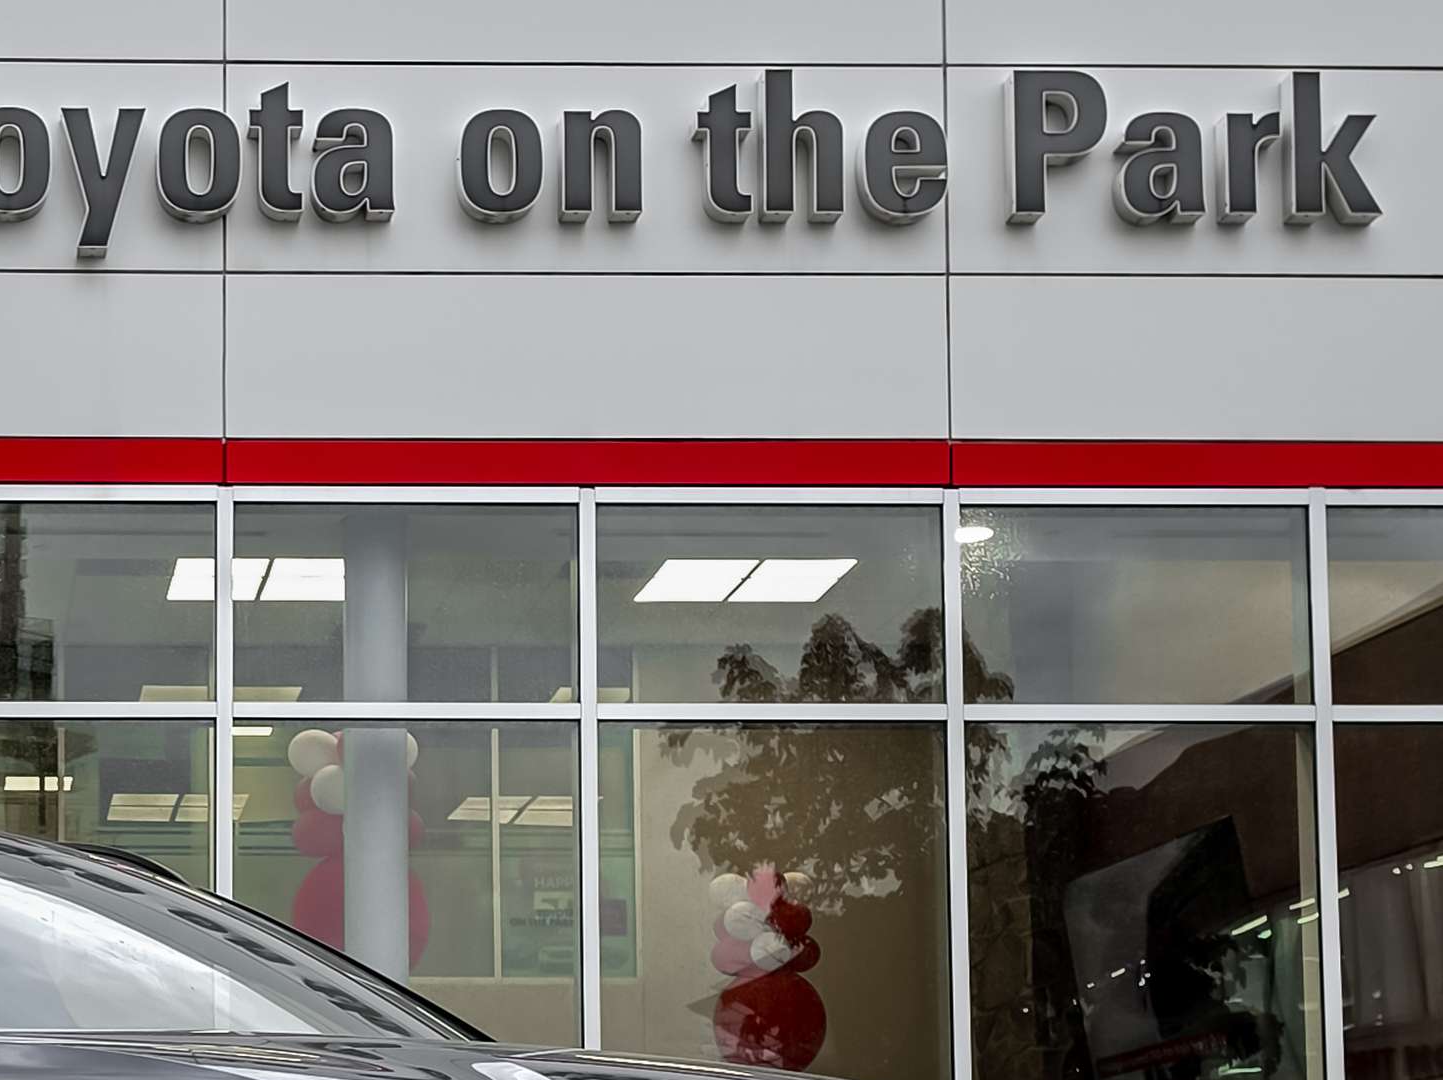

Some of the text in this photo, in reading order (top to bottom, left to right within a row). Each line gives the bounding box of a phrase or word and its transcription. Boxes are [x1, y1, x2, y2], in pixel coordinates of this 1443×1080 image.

[459, 108, 642, 223] on
[690, 68, 949, 225] the
[1002, 69, 1383, 227] Park
